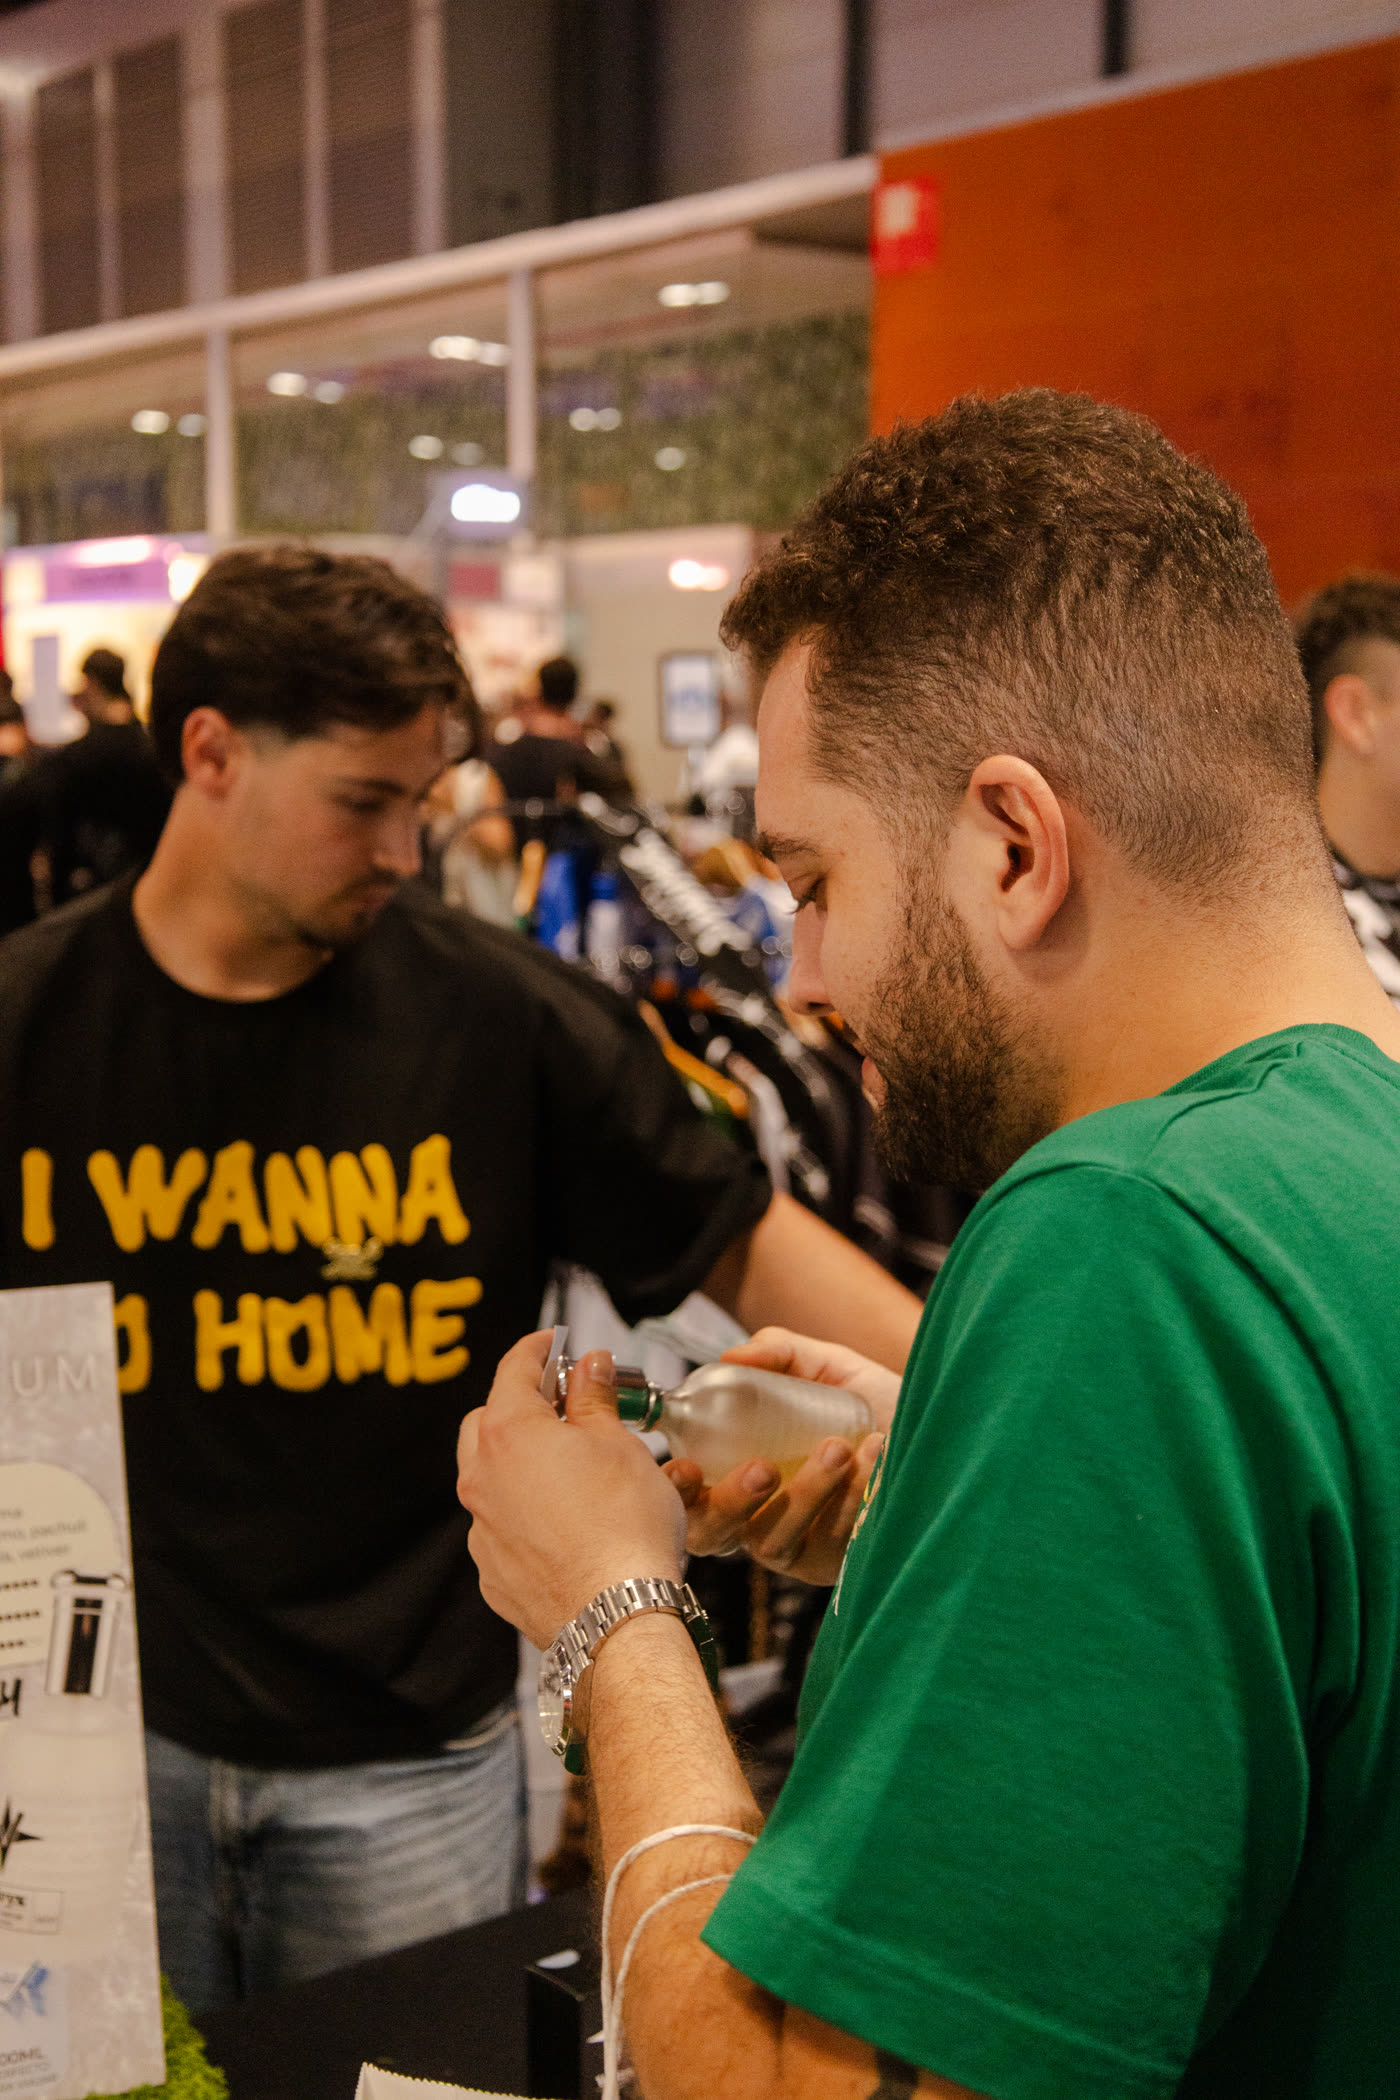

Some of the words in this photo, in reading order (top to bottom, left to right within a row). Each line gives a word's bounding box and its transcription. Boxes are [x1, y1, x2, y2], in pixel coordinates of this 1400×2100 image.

[21, 1147, 55, 1252] I
[87, 1134, 470, 1253] WANNA
[193, 1277, 483, 1392] HOME
